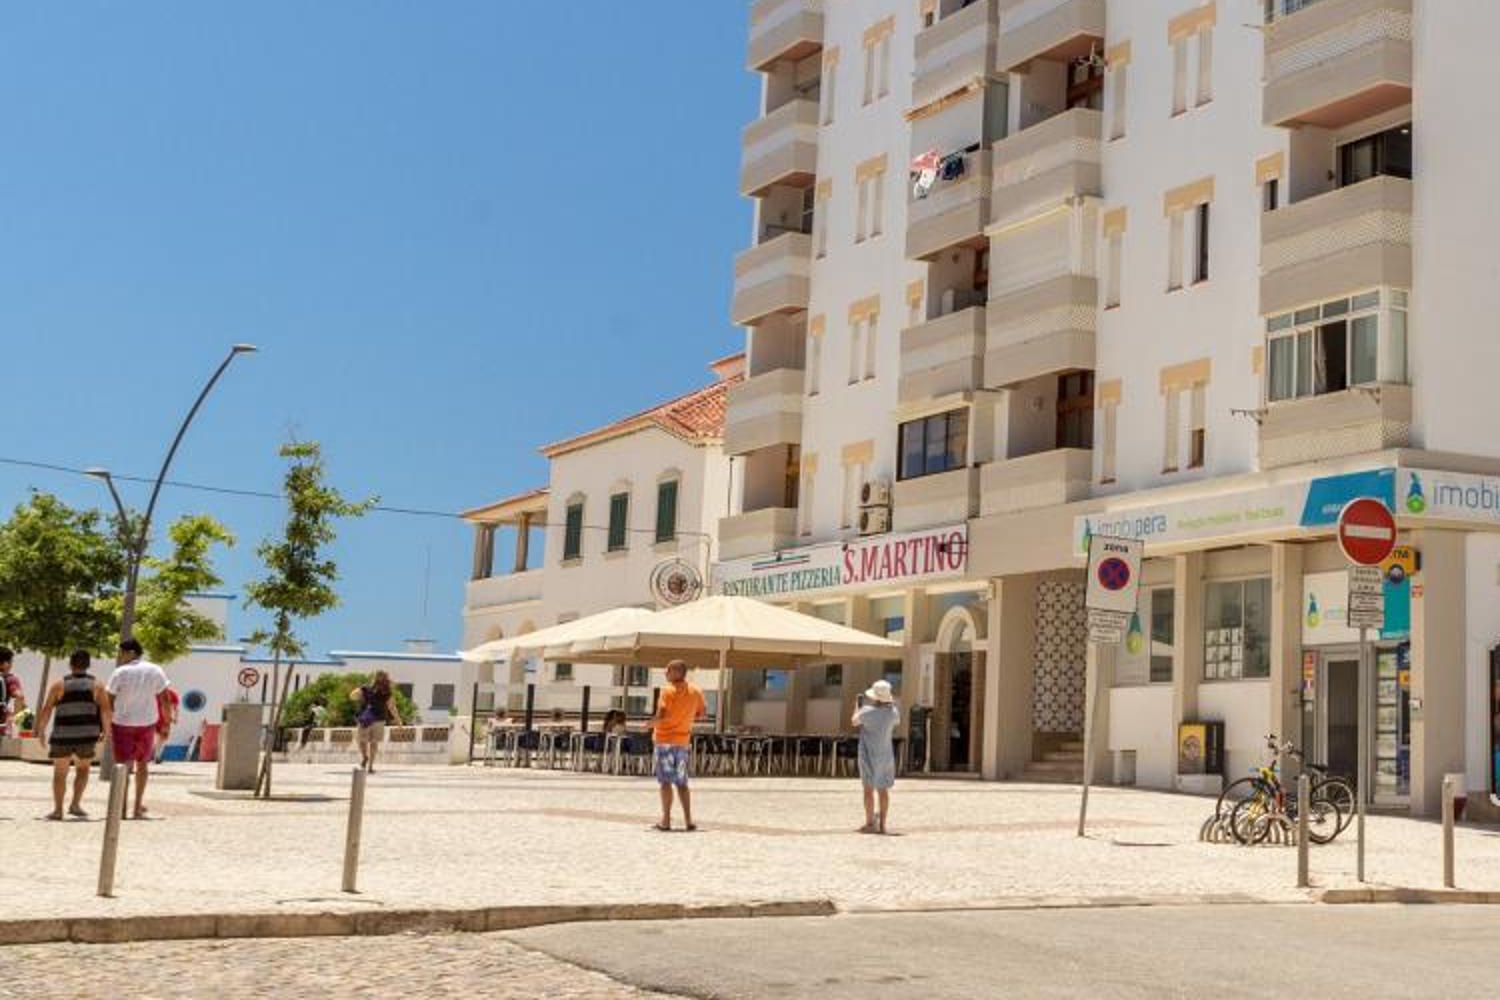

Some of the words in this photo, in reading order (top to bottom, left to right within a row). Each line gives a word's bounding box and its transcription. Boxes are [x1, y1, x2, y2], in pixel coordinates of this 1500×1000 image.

[723, 573, 788, 597] RISTORANTE
[790, 565, 841, 592] PIZZERIA
[843, 531, 964, 585] S.MARTINO
